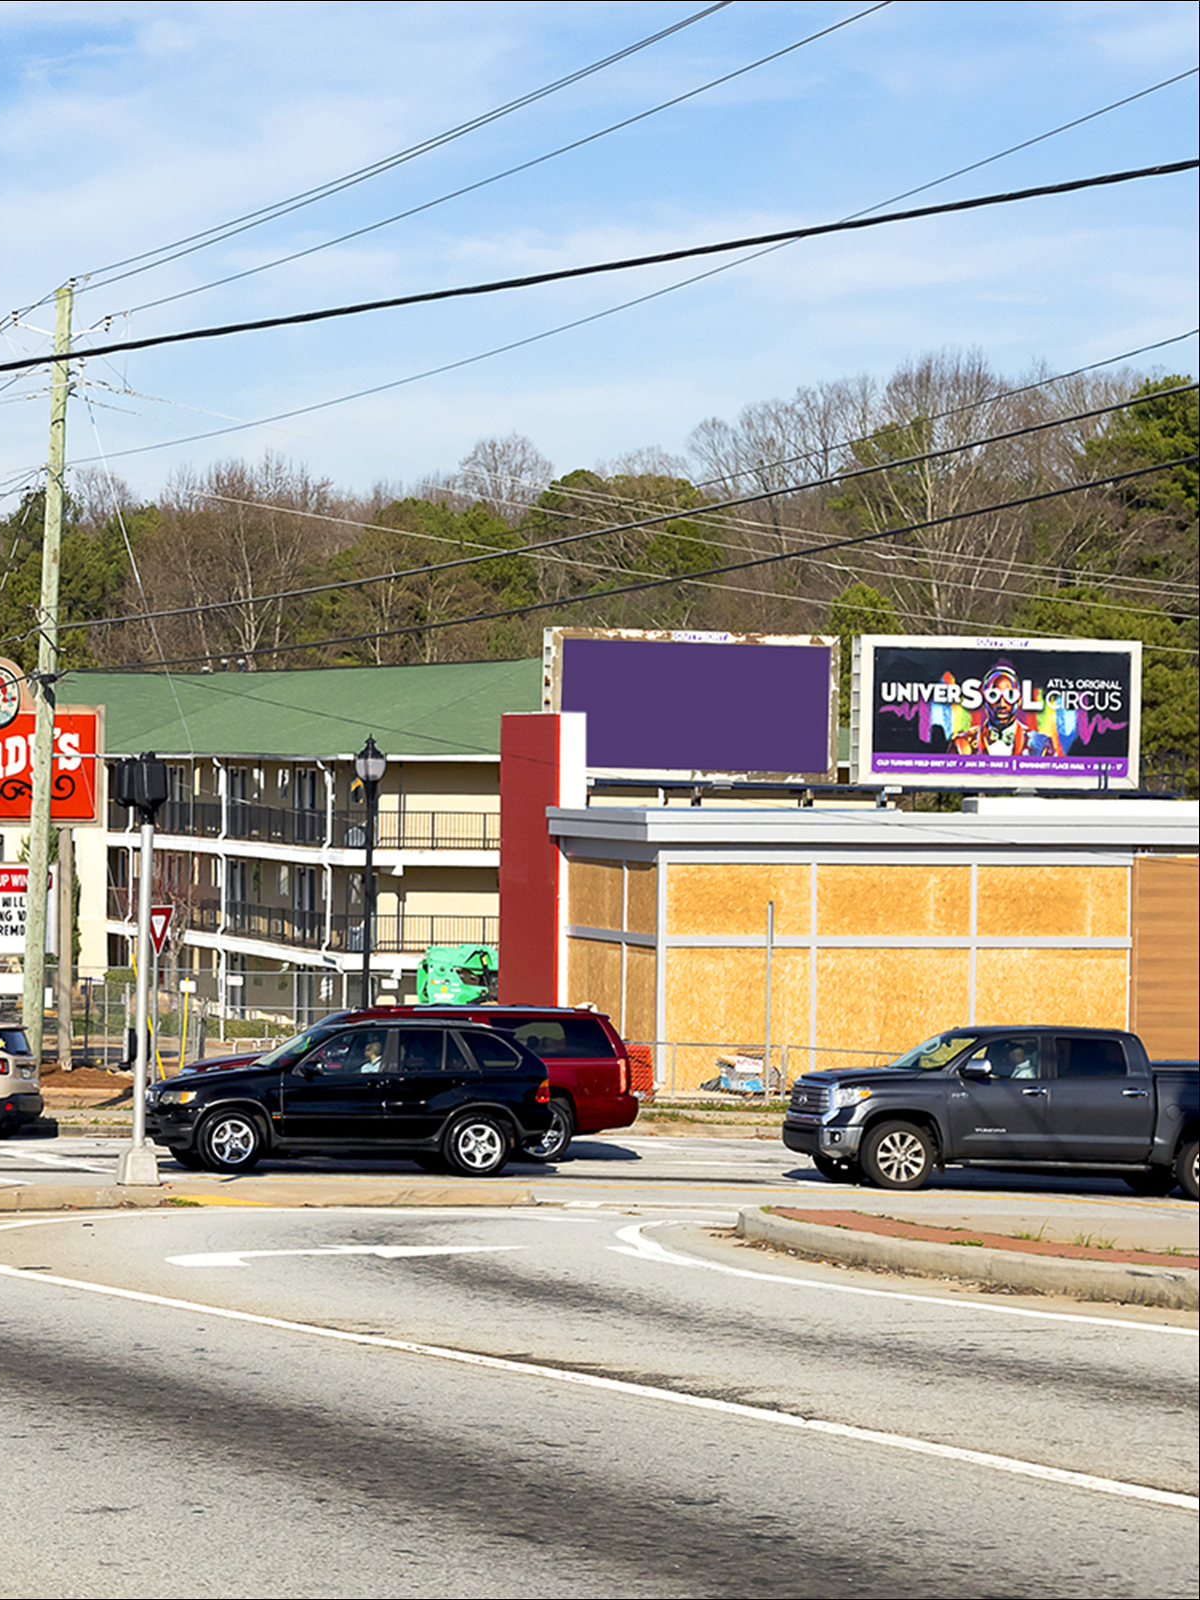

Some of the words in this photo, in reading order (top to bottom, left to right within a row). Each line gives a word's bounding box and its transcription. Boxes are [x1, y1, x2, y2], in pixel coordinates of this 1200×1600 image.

[1075, 679, 1122, 691] ORIGINAL
[1045, 690, 1122, 711] CIRCUS
[11, 874, 29, 887] WIN
[2, 896, 26, 908] WILL
